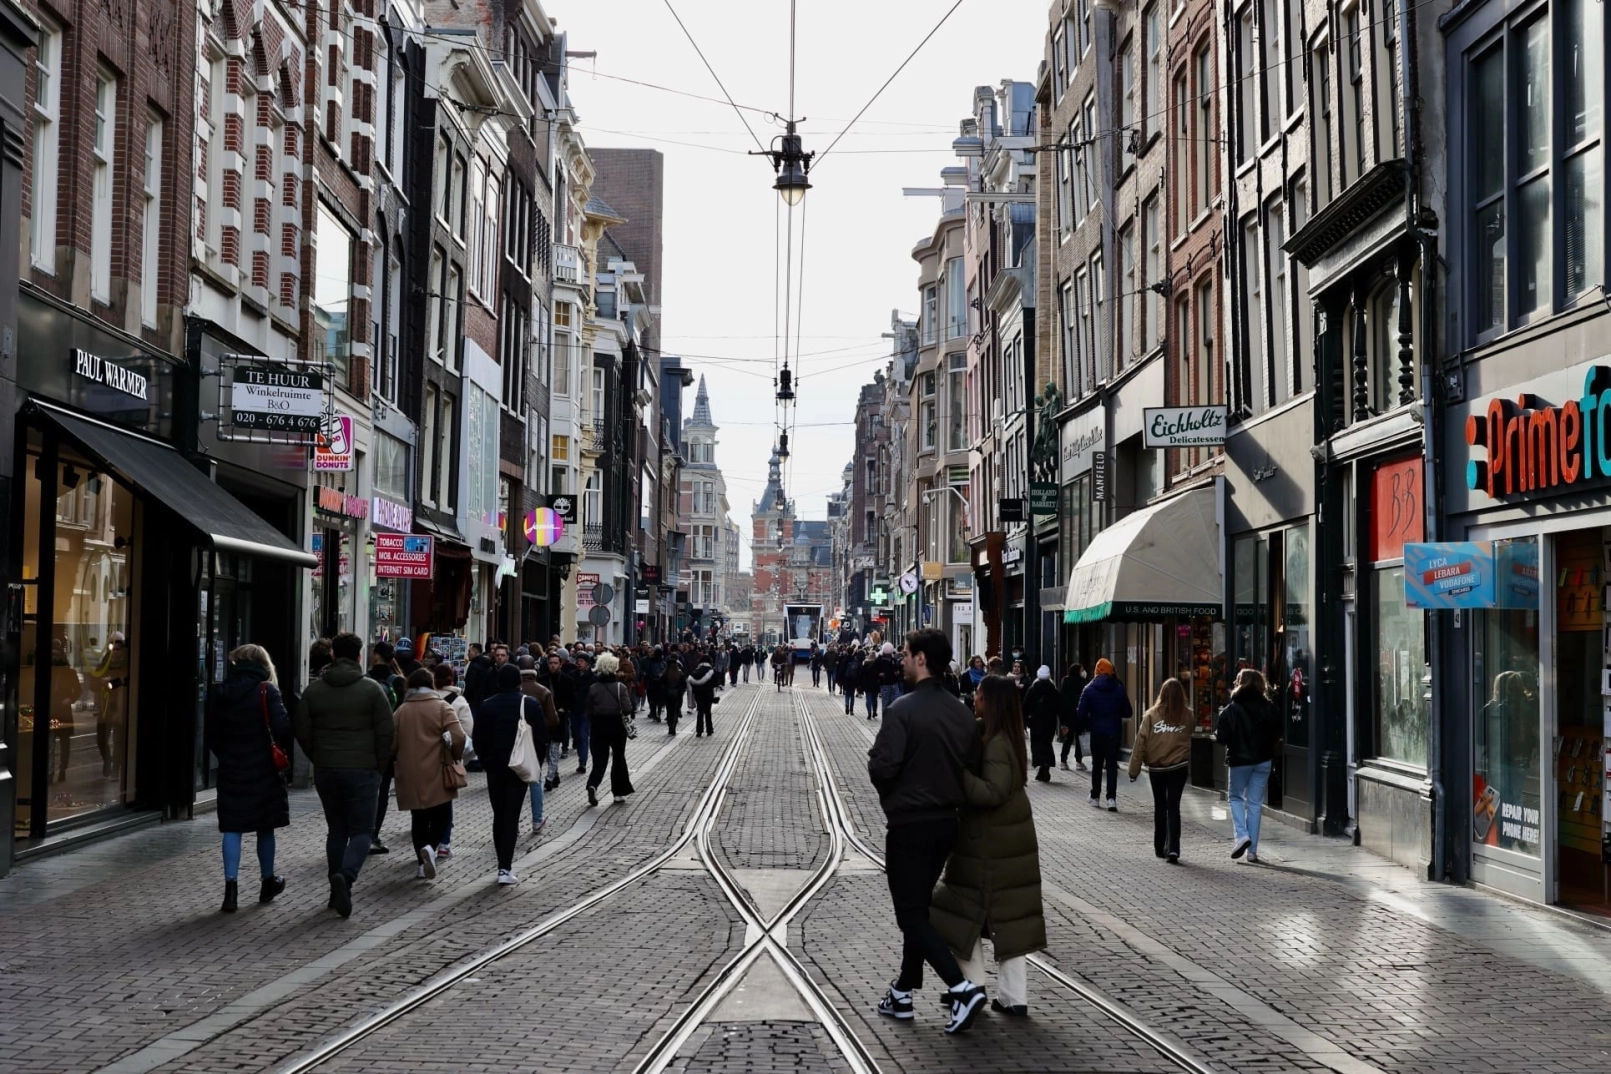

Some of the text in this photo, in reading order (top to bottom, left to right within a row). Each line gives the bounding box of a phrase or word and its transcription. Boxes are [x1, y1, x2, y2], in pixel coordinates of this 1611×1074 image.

[76, 348, 148, 400] PAUL WARMER
[246, 370, 311, 388] TE HUUR
[245, 385, 312, 400] Winkelruimte
[267, 399, 290, 411] B&O
[236, 412, 256, 423] 020
[266, 415, 285, 425] 676
[288, 416, 295, 426] 4
[297, 417, 317, 428] 676
[1150, 408, 1223, 438] Eichholtz
[1169, 436, 1225, 444] Delicatessen
[316, 461, 349, 469] DONUTS
[1095, 453, 1105, 500] MANFIELD
[379, 538, 404, 547] TOBACCO
[378, 552, 427, 562] MOB. ACCESSORIES
[1429, 558, 1448, 569] LYCA
[377, 565, 429, 576] INTERNET SIM CARD
[1434, 567, 1461, 580] LEBARA
[1439, 575, 1476, 589] VODAFONE
[1142, 606, 1159, 614] AND
[1160, 607, 1192, 615] BRITISH
[1193, 607, 1217, 615] FOOD
[1501, 802, 1539, 825] REPAIR YOUR
[1502, 821, 1522, 840] PHONE
